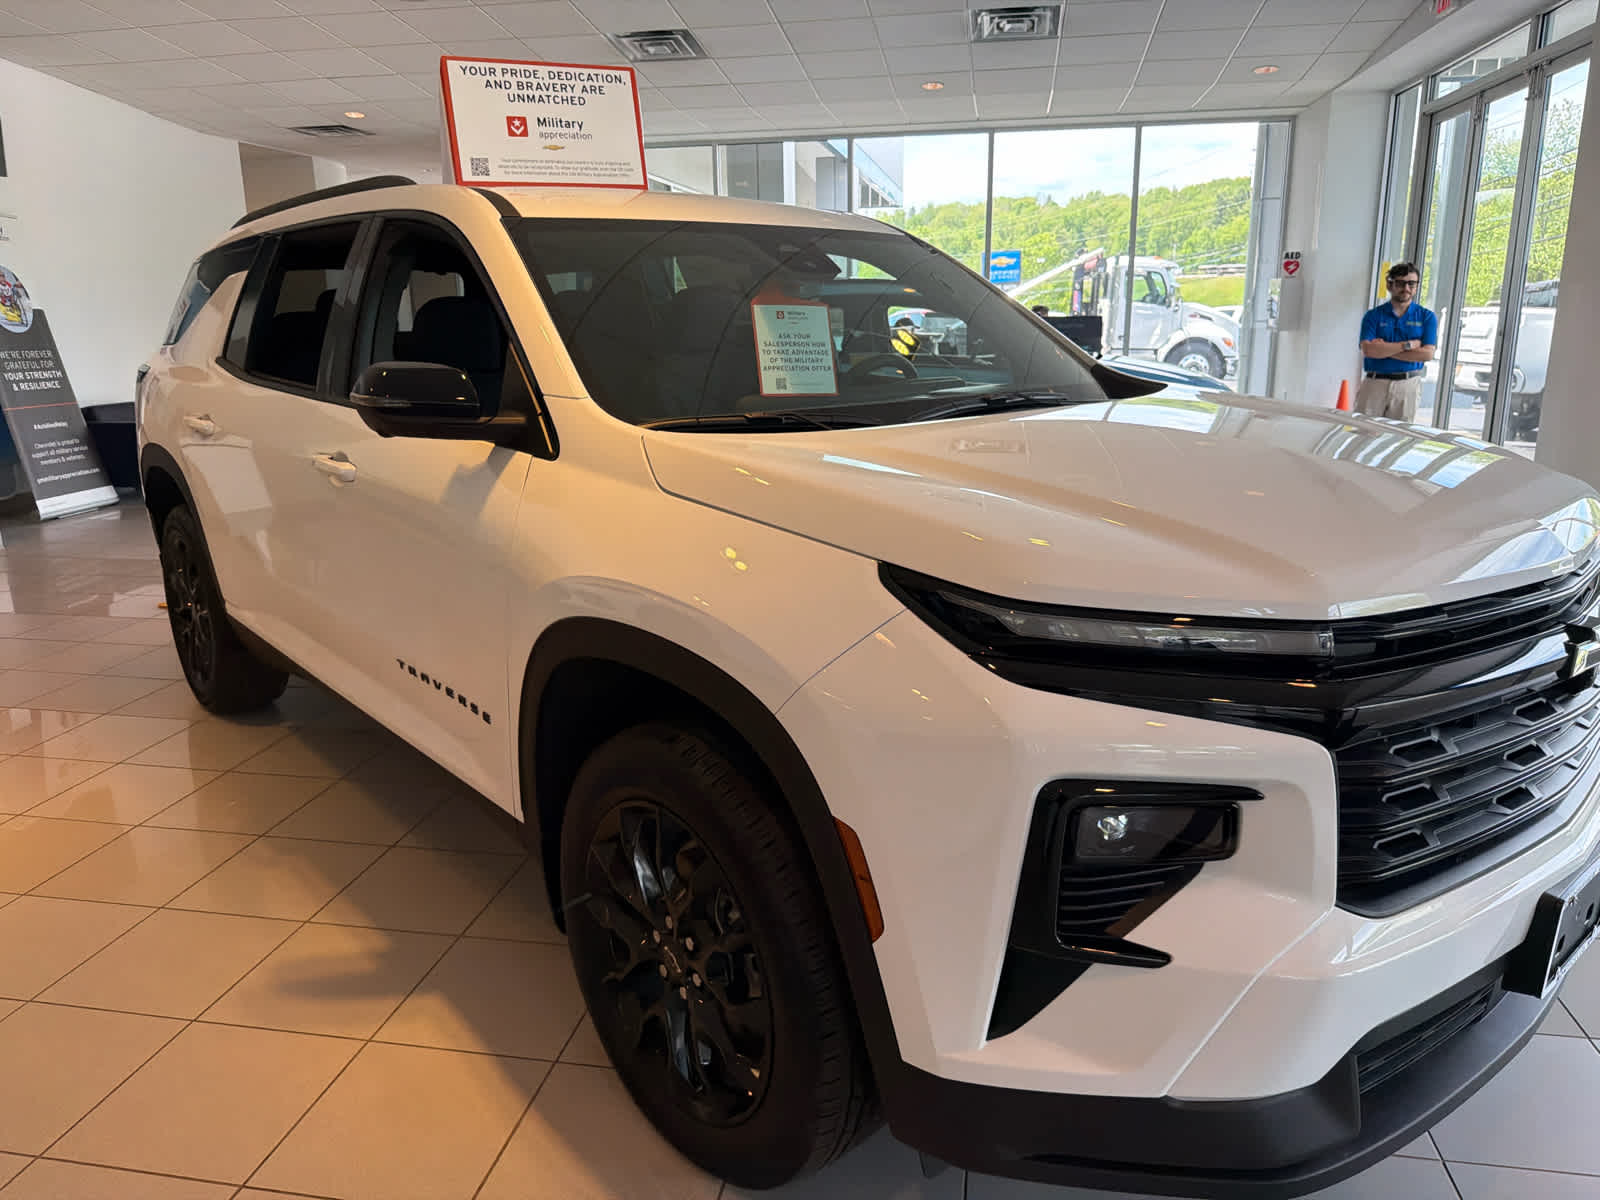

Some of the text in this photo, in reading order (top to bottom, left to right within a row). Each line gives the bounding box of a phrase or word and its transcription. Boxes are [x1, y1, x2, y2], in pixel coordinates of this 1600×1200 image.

[460, 65, 626, 86] YOUR PRIDE, DEDICATION,
[485, 79, 606, 96] AND BRAVERY ARE
[507, 93, 586, 106] UNMATCHED
[537, 117, 584, 131] Military
[539, 131, 593, 141] appreciation
[1284, 251, 1301, 260] AED
[22, 350, 53, 359] FOREVER
[4, 360, 55, 370] GRATEFUL FOR
[3, 370, 63, 380] YOUR STRENGTH
[12, 381, 62, 391] & RESILIENCE
[396, 658, 491, 725] TRAVERSE
